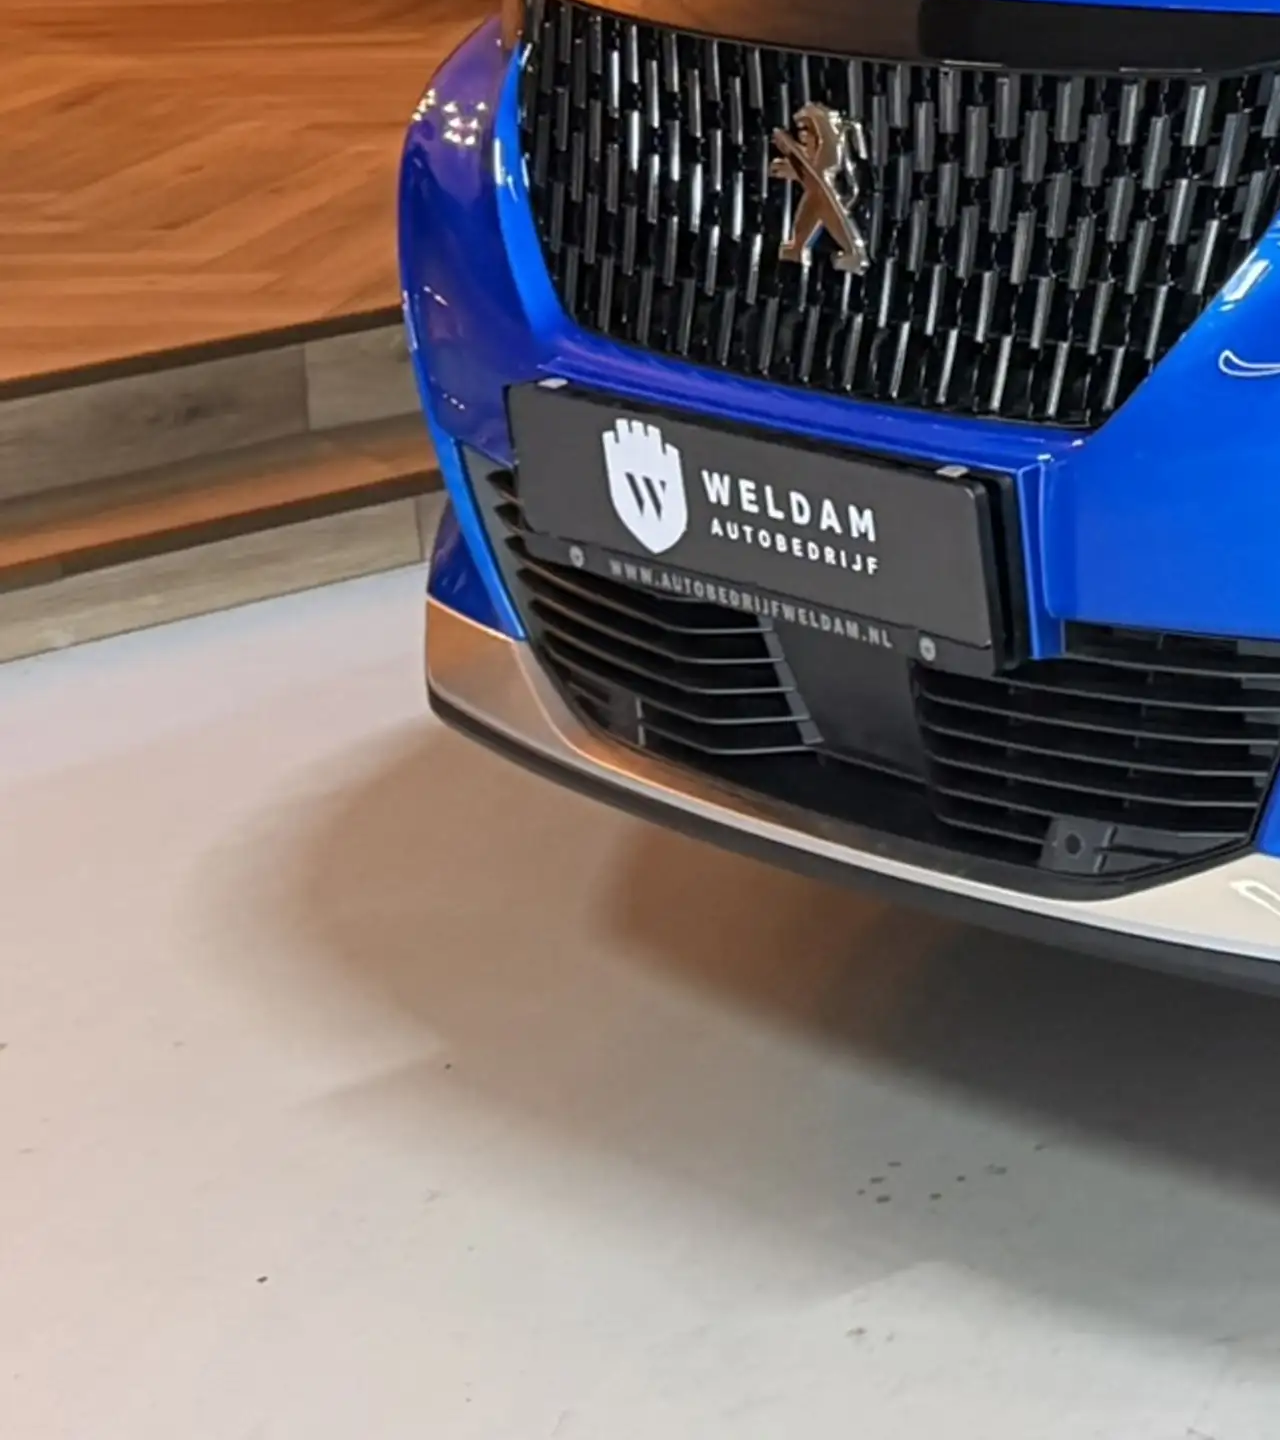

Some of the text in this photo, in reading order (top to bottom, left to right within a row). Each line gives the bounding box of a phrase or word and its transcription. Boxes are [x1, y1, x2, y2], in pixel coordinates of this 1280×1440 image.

[701, 469, 877, 543] WELDAM
[710, 516, 879, 576] AUTOBEDRIJF
[608, 559, 893, 649] WWW.AUTOBEDRIJFWELDAM.NL
